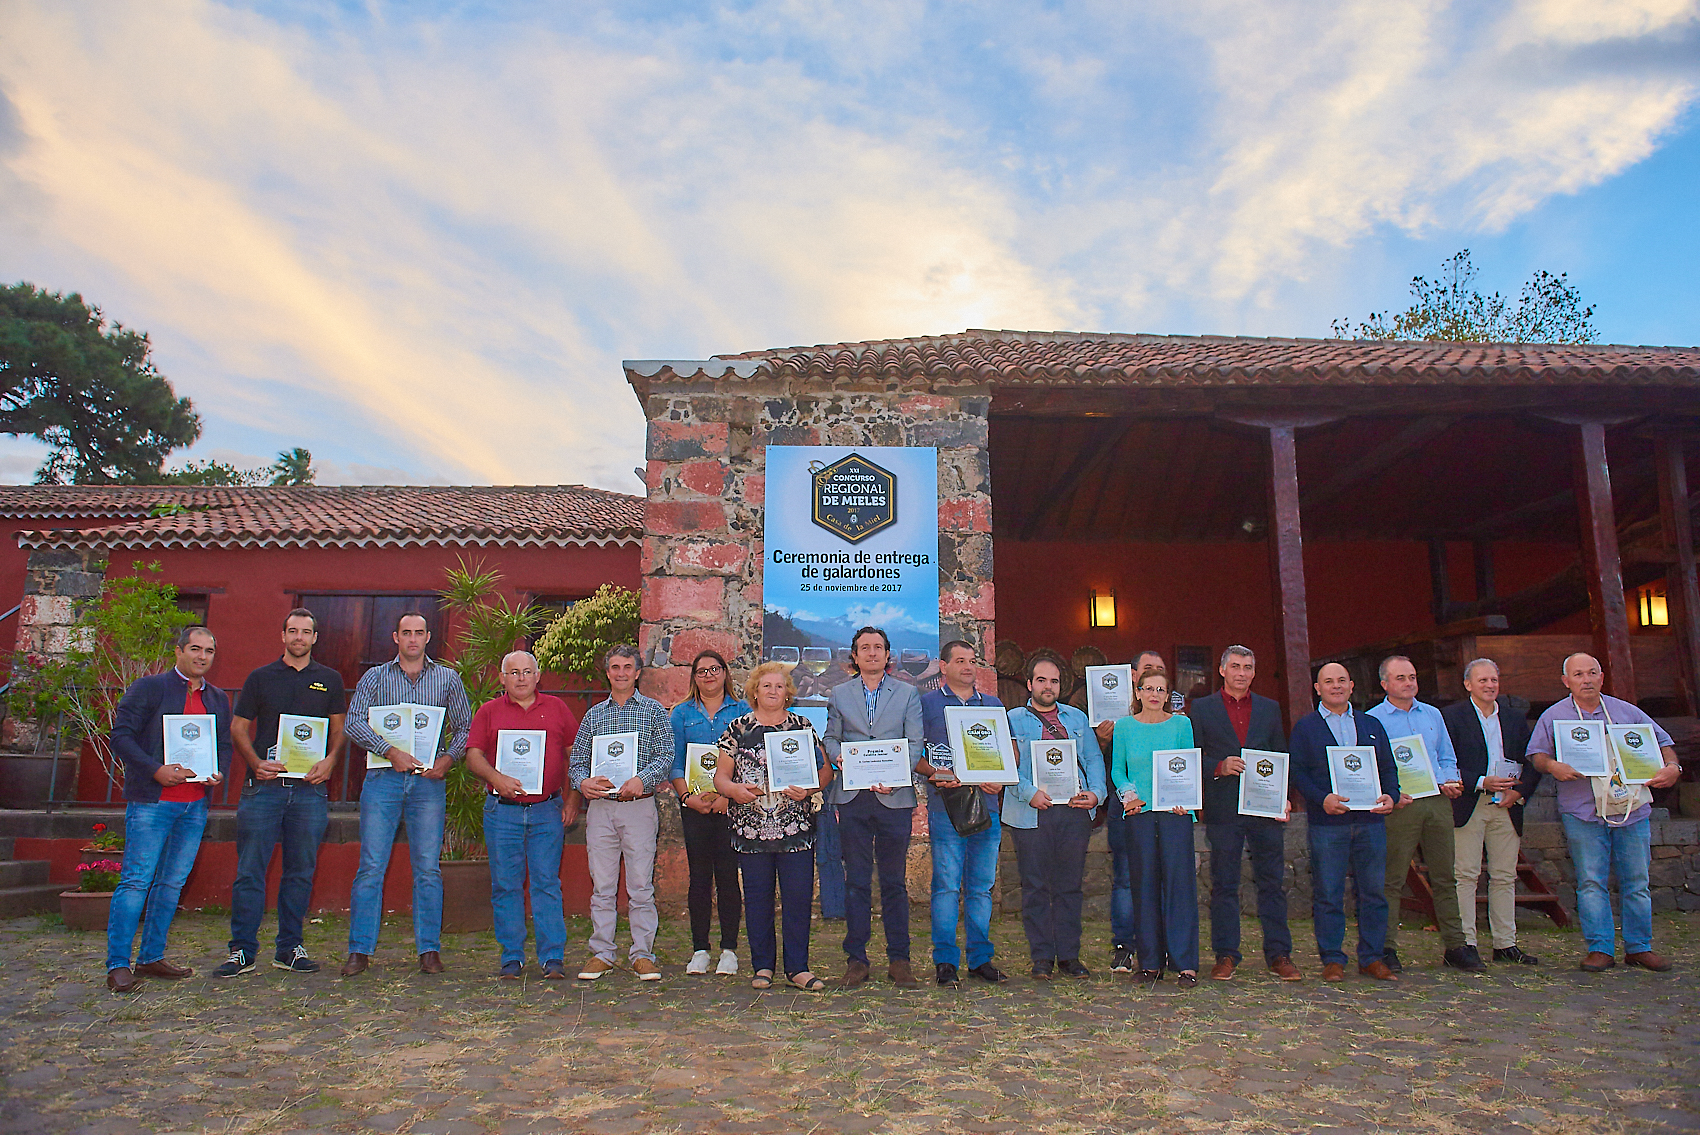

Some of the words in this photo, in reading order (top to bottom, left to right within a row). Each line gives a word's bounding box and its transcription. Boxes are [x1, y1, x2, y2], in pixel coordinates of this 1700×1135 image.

[833, 474, 876, 482] CONCURSO
[824, 483, 886, 494] REGIONAL
[822, 495, 839, 506] DE
[841, 495, 886, 506] MIELES
[826, 513, 842, 526] Casa
[843, 523, 852, 532] de
[865, 514, 881, 527] Miel
[773, 549, 850, 564] Ceremonia
[854, 550, 871, 564] de
[875, 551, 930, 567] entrega
[801, 565, 819, 579] de
[823, 565, 901, 581] galardones
[800, 584, 811, 592] 25
[813, 584, 823, 592] de
[825, 584, 867, 592] noviembre
[869, 584, 880, 592] de
[881, 584, 902, 592] 2017
